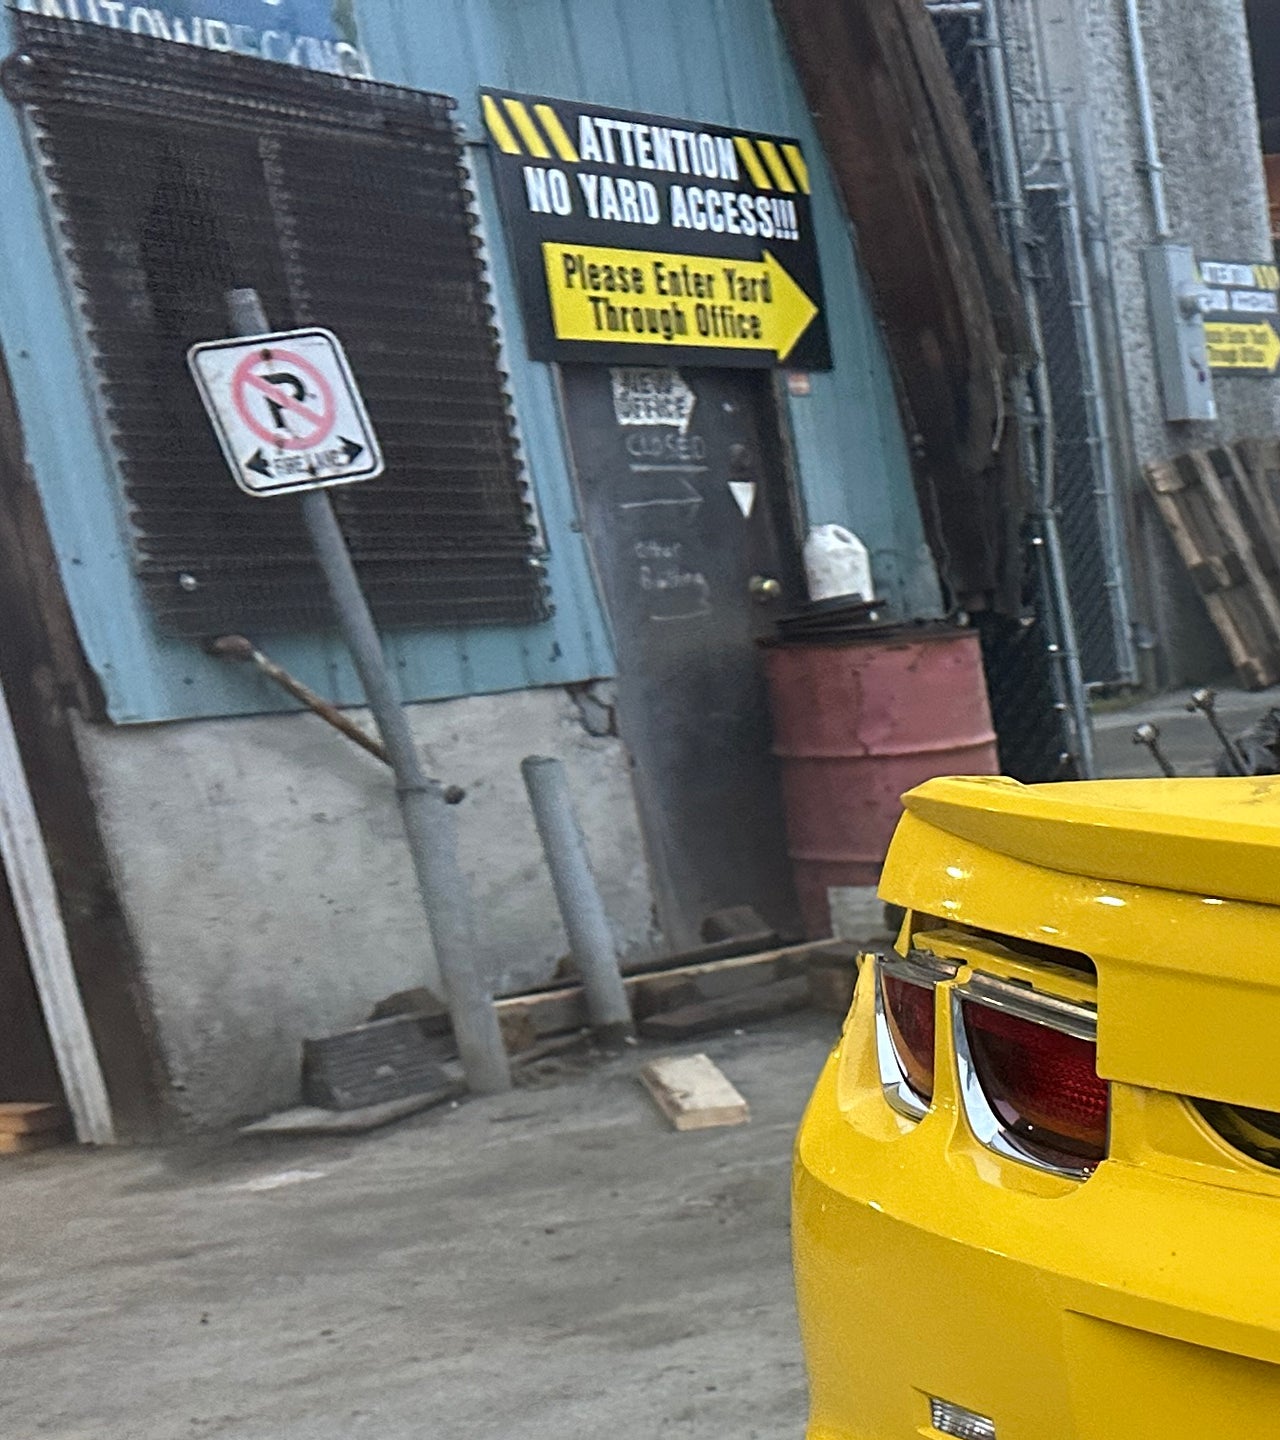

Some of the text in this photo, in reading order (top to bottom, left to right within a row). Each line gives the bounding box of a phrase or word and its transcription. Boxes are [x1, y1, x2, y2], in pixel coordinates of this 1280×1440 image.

[578, 115, 739, 181] ATTENTION
[523, 166, 800, 241] NO YARD ACCESS!!!
[562, 252, 773, 303] Please Enter Yard
[589, 295, 763, 341] Through Office
